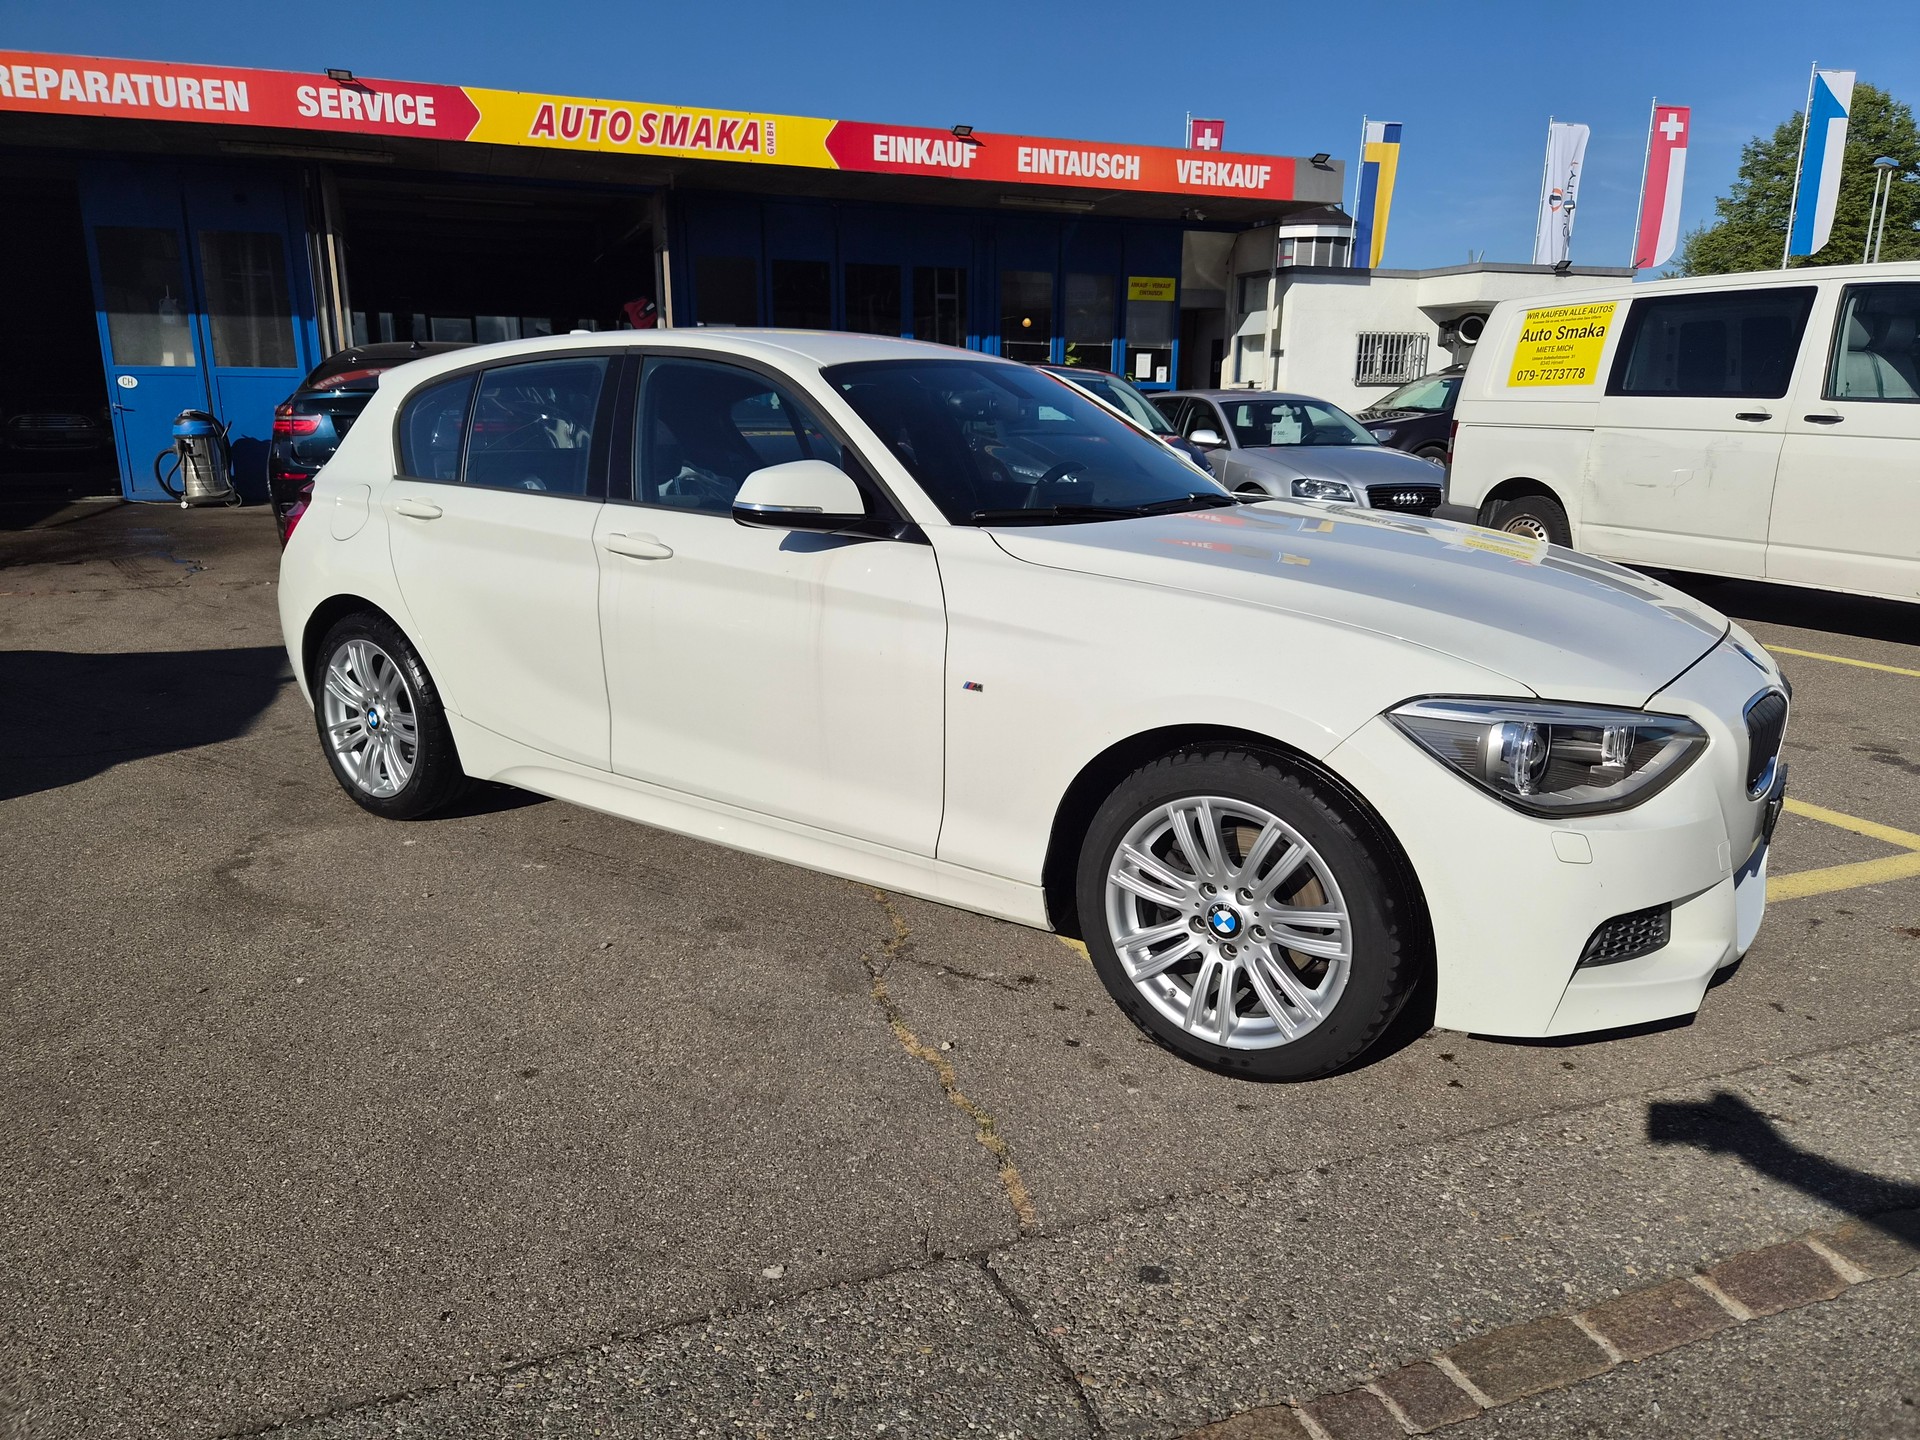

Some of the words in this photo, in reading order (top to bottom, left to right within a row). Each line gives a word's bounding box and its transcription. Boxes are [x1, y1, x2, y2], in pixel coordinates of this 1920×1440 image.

[0, 64, 249, 112] REPARATUREN
[297, 85, 436, 126] SERVICE
[530, 103, 633, 142] AUTO
[638, 112, 760, 154] SMAKA
[766, 121, 775, 155] GMBH
[873, 134, 977, 169] EINKAUF
[1017, 146, 1140, 181] EINTAUSCH
[1176, 159, 1271, 190] VERKAUF
[1527, 312, 1539, 320] WIR
[1540, 310, 1568, 318] KAUFEN
[1569, 307, 1587, 316] ALLE
[1588, 305, 1614, 314] AUTOS
[1520, 328, 1552, 343] Auto
[1556, 322, 1605, 340] Smaka
[1536, 345, 1555, 353] MIETE
[1556, 344, 1574, 352] MICH
[122, 377, 134, 386] CH
[1517, 367, 1586, 381] 079-7273778
